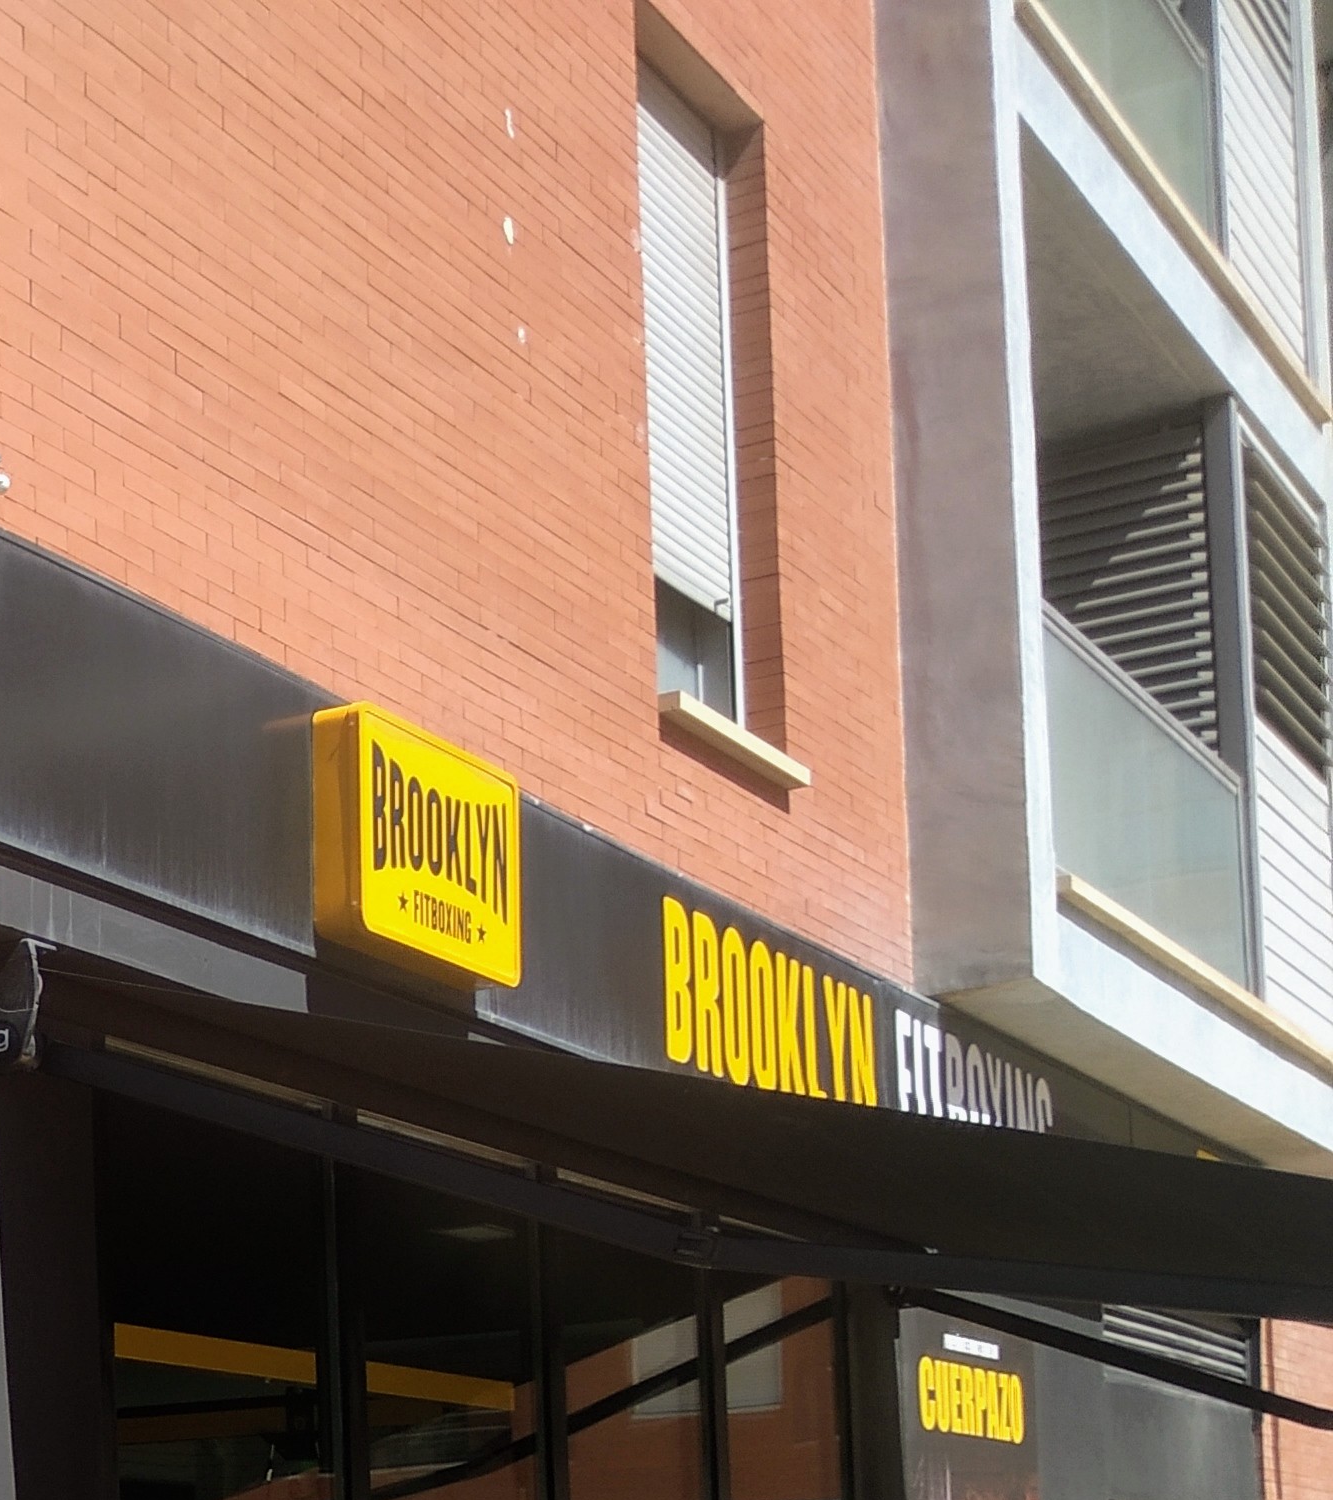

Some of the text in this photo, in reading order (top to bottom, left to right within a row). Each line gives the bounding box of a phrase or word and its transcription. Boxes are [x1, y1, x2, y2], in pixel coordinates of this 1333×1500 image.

[371, 740, 508, 925] BROOKLYN
[412, 890, 473, 944] FITBOXING
[663, 895, 878, 1109] BROOKLYN
[918, 1355, 1025, 1445] CUERPAZO
